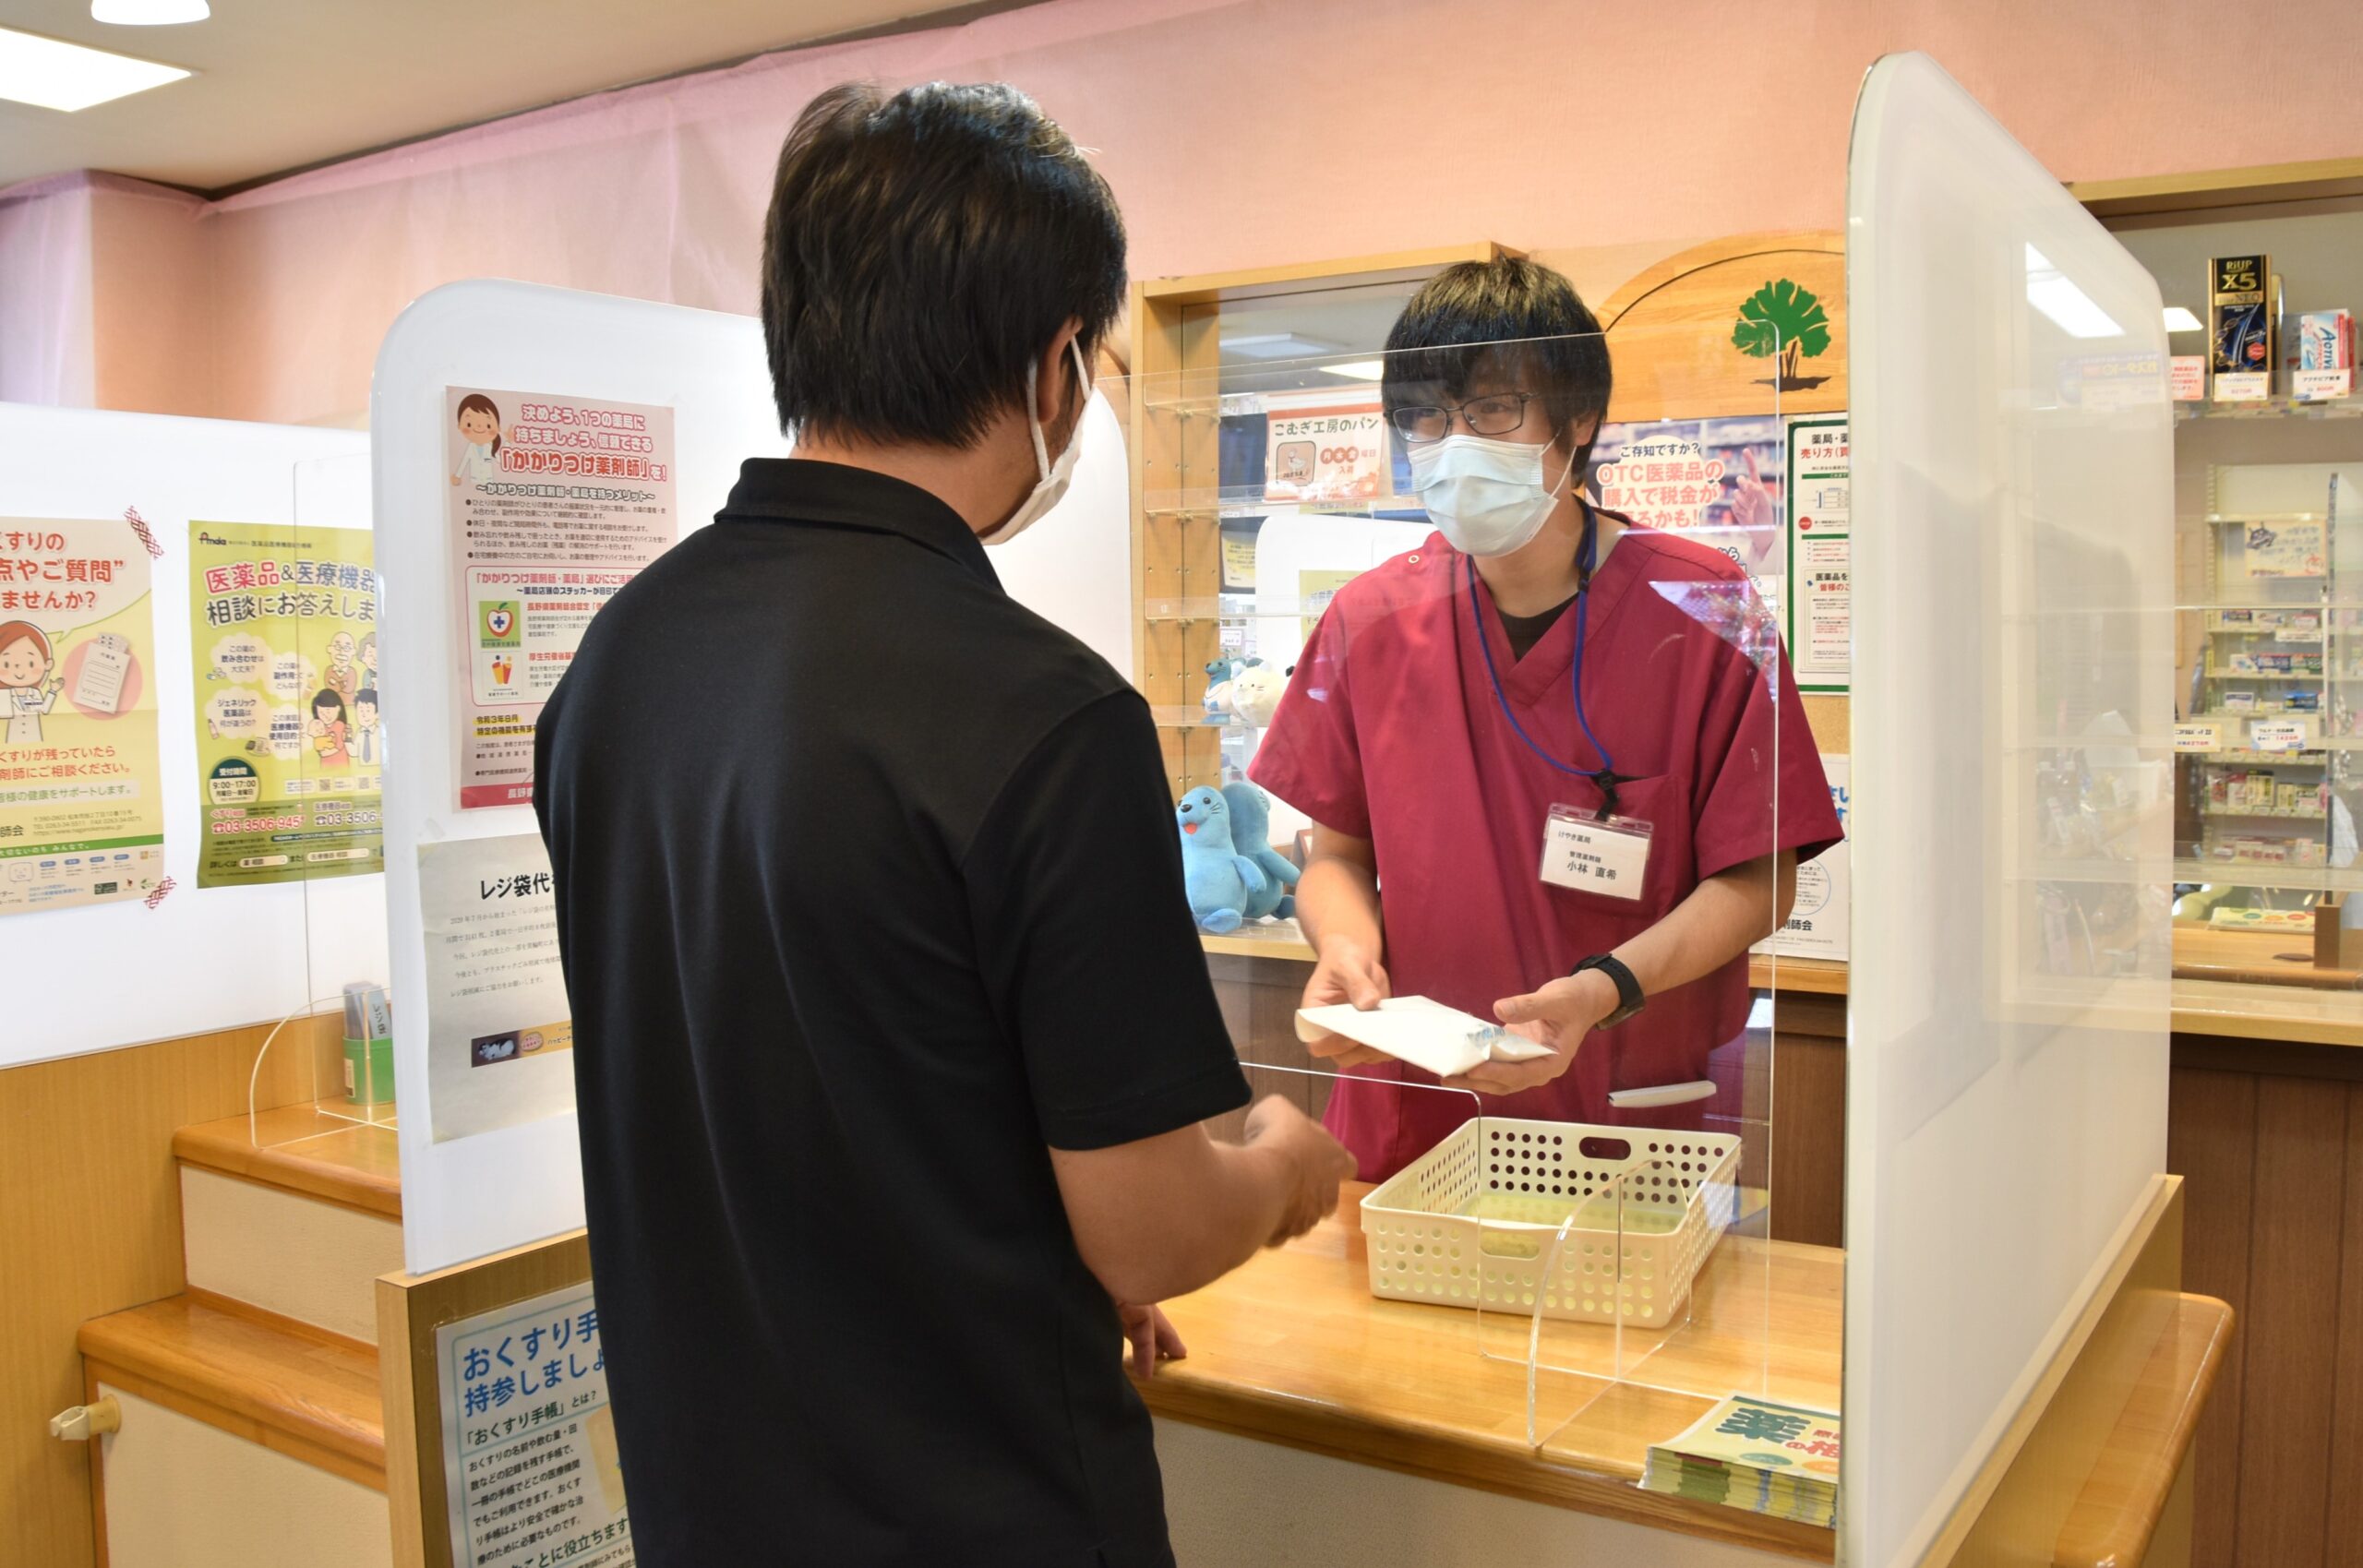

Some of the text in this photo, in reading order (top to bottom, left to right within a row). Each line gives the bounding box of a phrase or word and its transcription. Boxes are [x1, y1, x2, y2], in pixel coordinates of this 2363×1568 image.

[2222, 272, 2257, 290] X5
[1275, 416, 1379, 436] こむぎ工房のパン
[1620, 442, 1699, 458] ご存知ですか?
[1597, 460, 1723, 484] OTC医薬品の
[1603, 482, 1719, 508] 購入で税金が
[0, 532, 65, 551] すりの
[2, 591, 96, 609] ませんか?
[0, 746, 115, 762] くすりが残っていたら
[1566, 861, 1589, 874] 小林
[481, 872, 554, 900] レジ袋代
[464, 1309, 599, 1382] おくすり手
[464, 1348, 606, 1418] 持参しましょ
[467, 1391, 596, 1445] 「おくすり手帳」 とは?
[469, 1423, 578, 1473] おくすりの名前や飲む量・回
